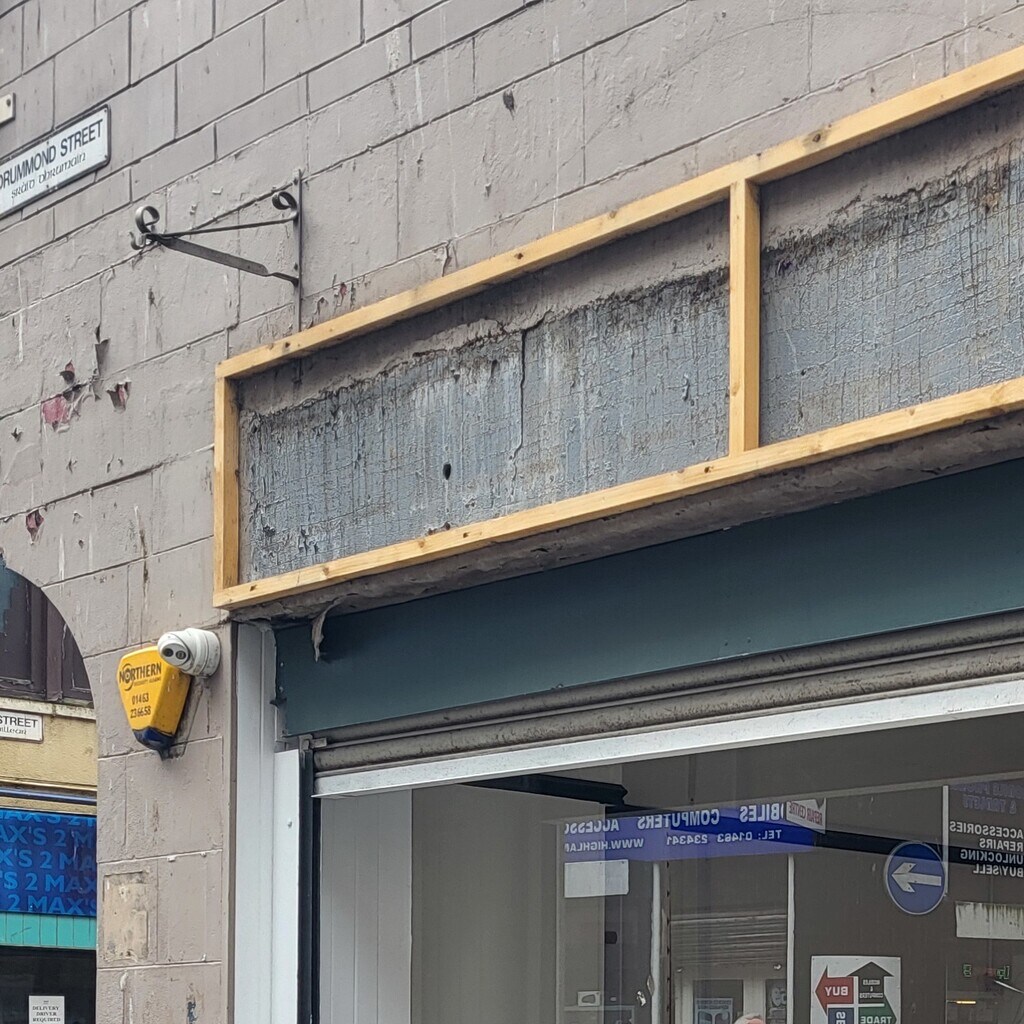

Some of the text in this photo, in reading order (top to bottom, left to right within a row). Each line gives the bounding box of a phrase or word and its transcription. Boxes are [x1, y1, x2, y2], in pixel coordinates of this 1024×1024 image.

[60, 119, 103, 157] STREET
[119, 662, 162, 684] NORTHERN
[0, 715, 38, 728] STREET
[40, 851, 53, 870] 2
[25, 872, 38, 891] 2
